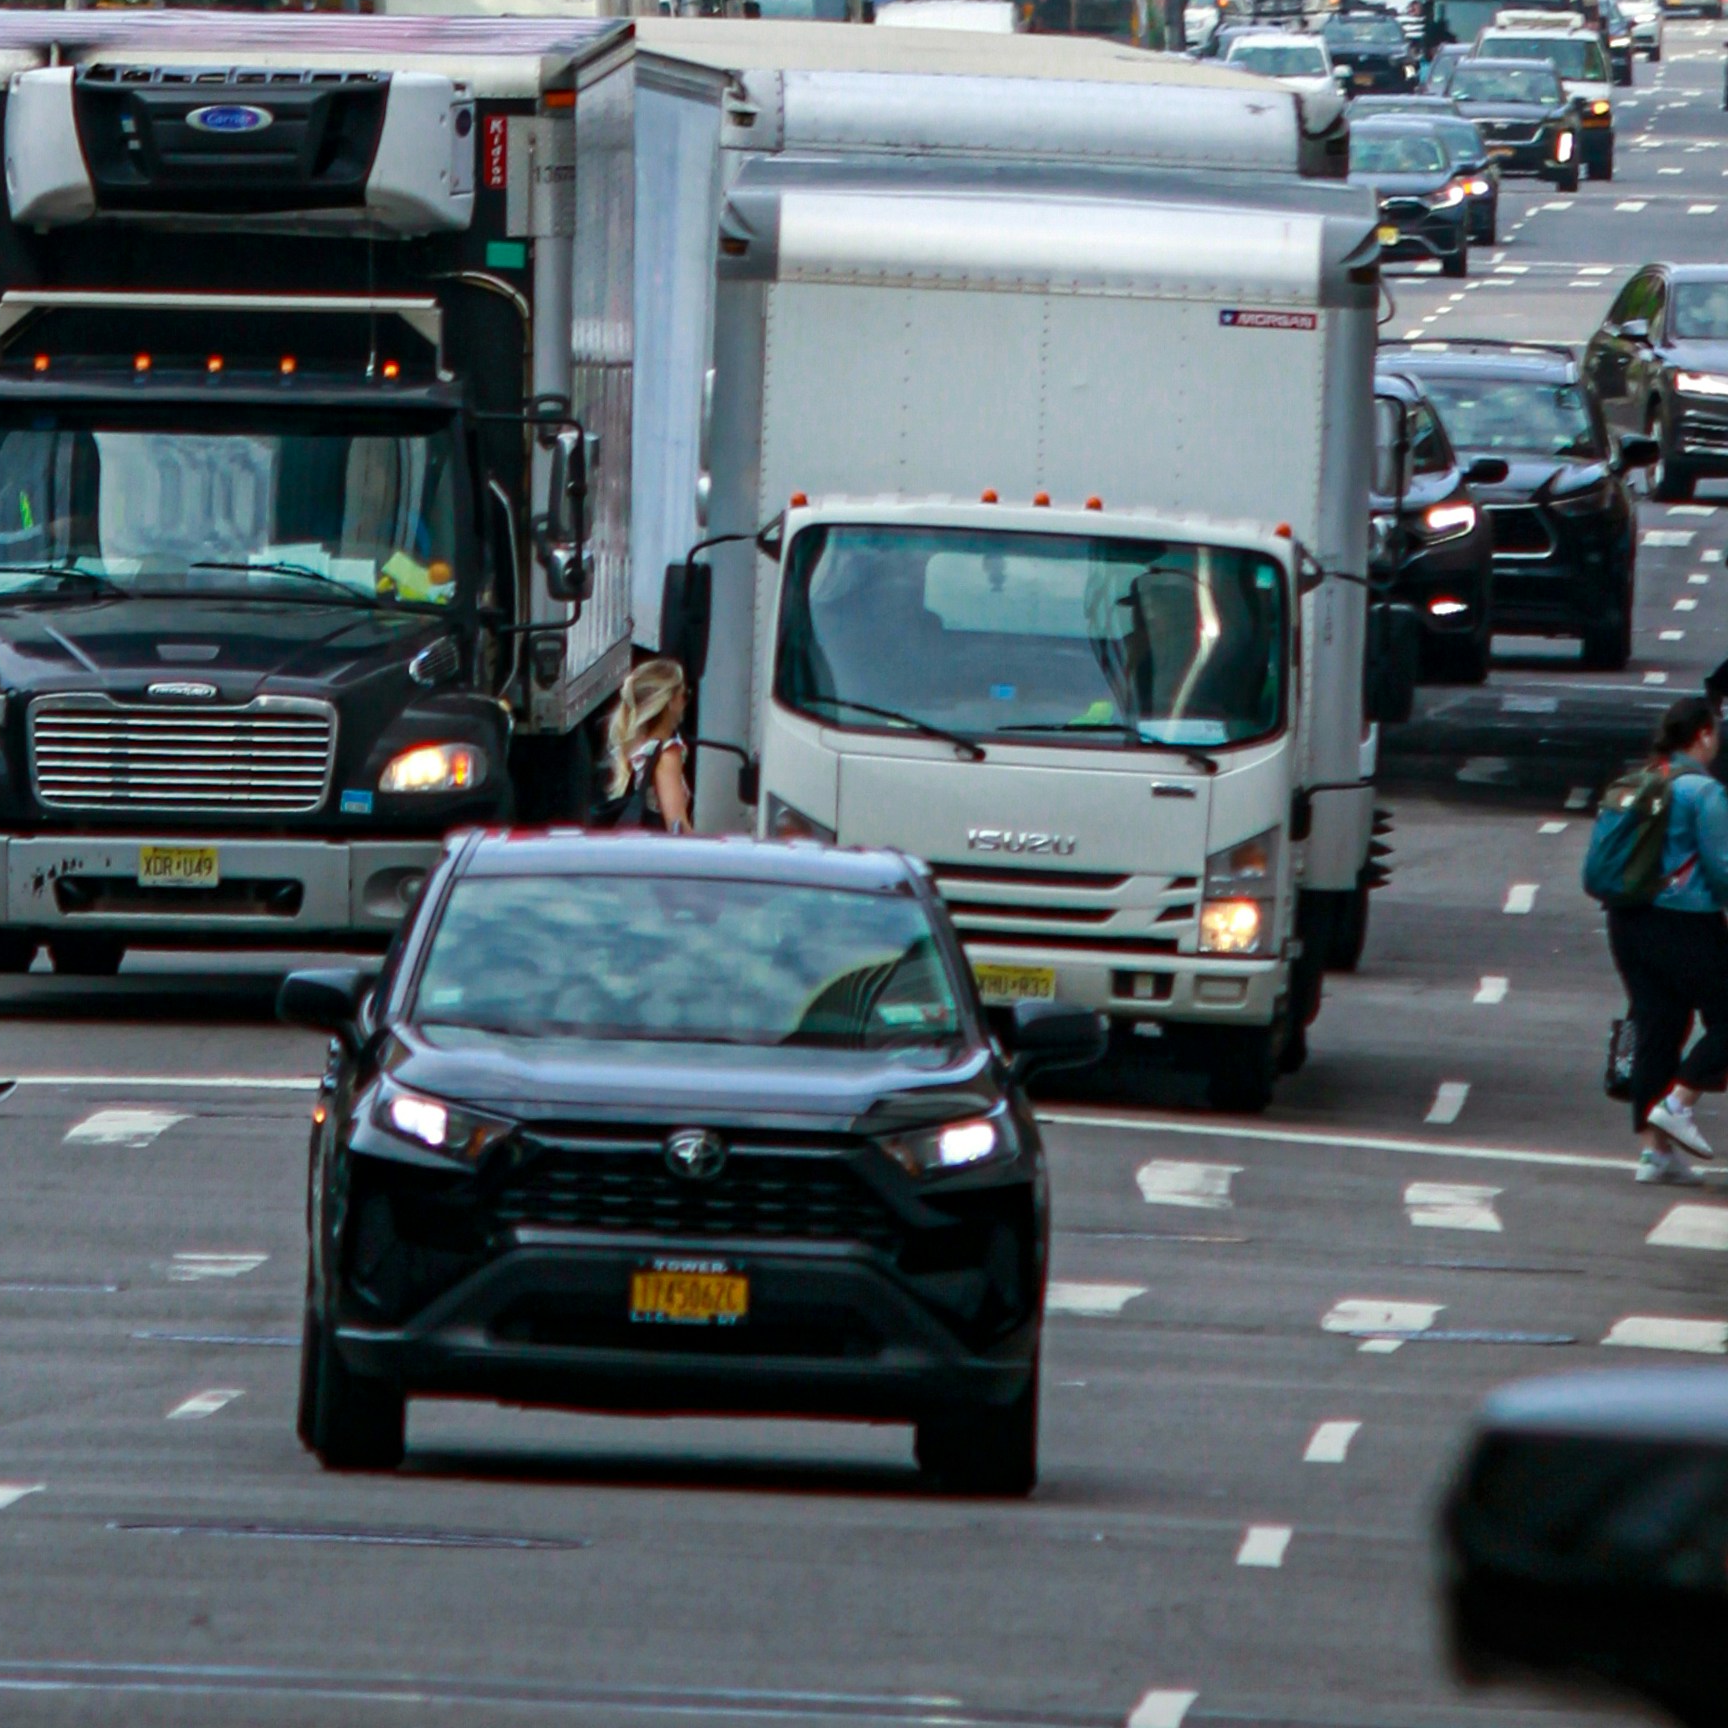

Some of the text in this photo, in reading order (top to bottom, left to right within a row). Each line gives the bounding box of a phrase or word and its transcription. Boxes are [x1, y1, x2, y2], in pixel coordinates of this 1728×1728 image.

[489, 119, 503, 185] Kidron
[1238, 313, 1313, 328] MORGAN
[968, 829, 1075, 855] ISUZU
